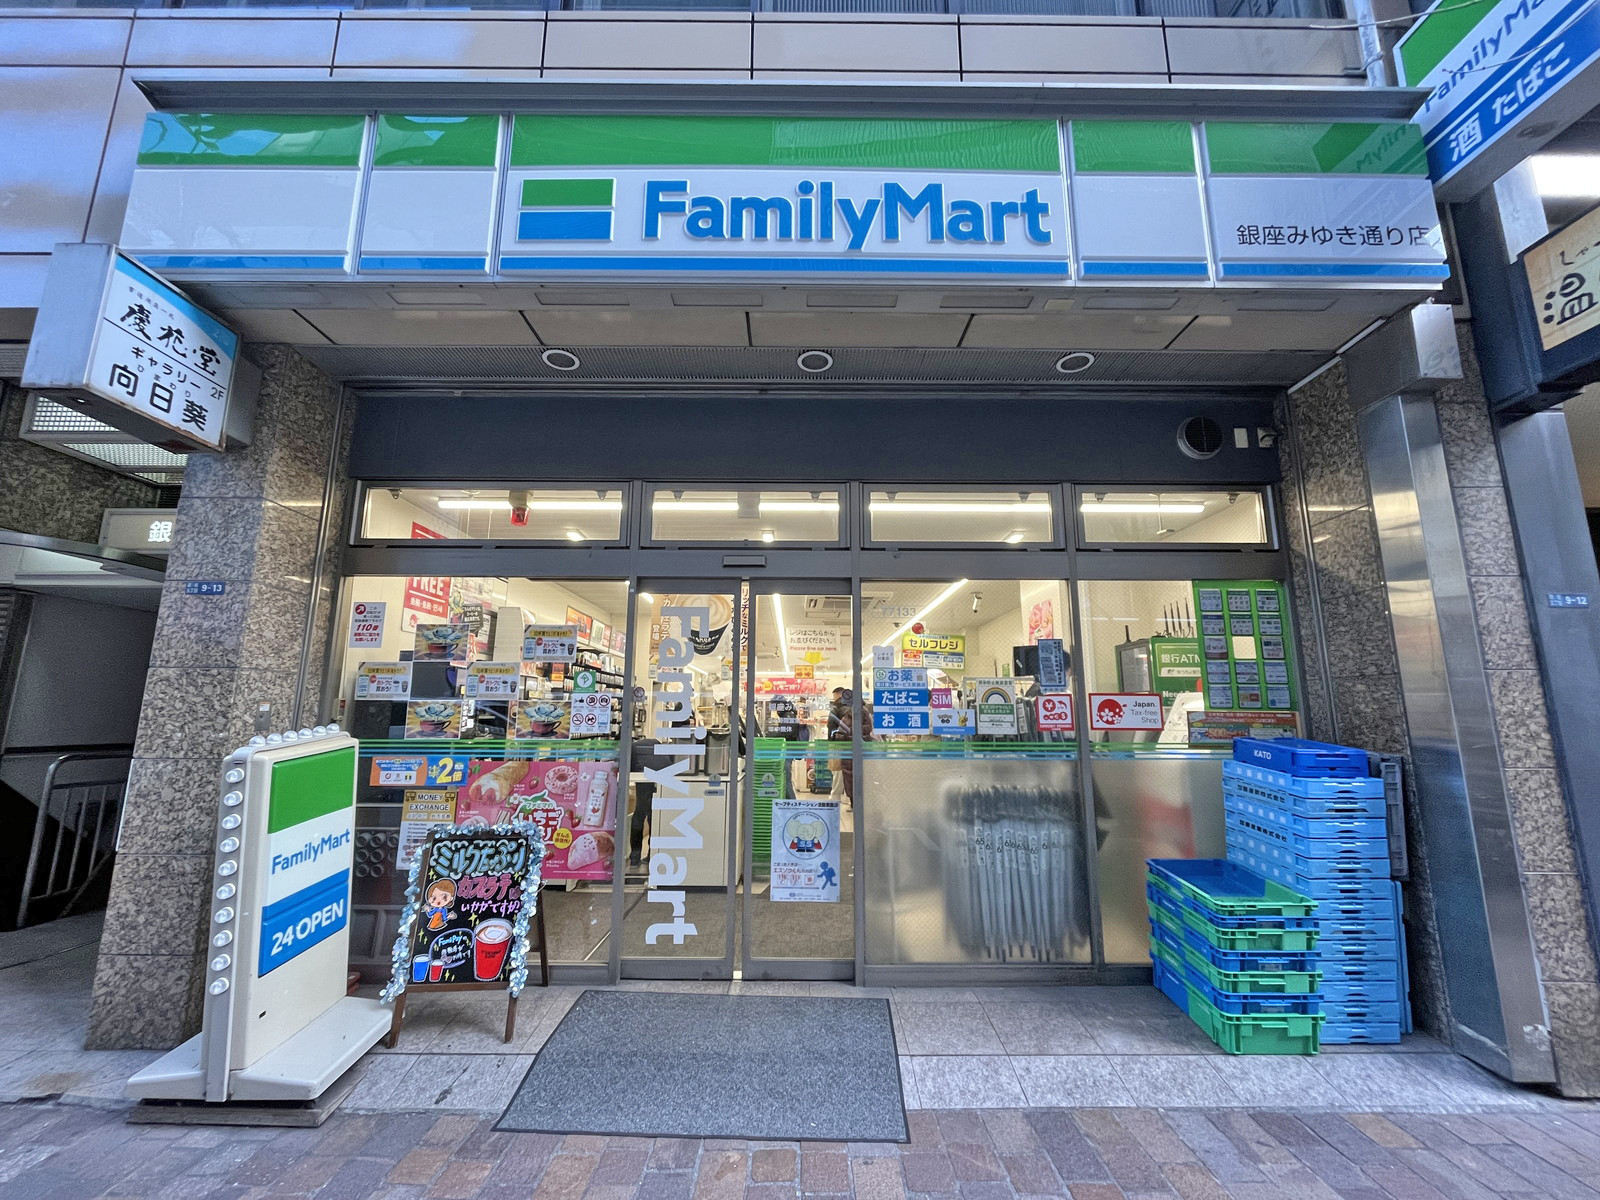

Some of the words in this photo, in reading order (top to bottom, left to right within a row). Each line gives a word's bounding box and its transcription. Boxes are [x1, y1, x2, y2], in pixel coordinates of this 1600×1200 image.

[1449, 112, 1482, 161] 酒
[1492, 42, 1570, 124] たばこ
[642, 178, 1053, 253] FamilyMart
[1236, 225, 1431, 247] 銀座みゆき通り店
[1560, 241, 1600, 266] しゃ
[131, 346, 202, 389] ギャラリー
[210, 387, 225, 401] 2F
[108, 363, 209, 432] 向日葵
[201, 584, 222, 592] 9-13
[1564, 596, 1588, 605] 9-12
[909, 638, 959, 650] セルフレジ
[888, 669, 913, 682] お薬
[881, 691, 920, 705] たばこ
[932, 694, 952, 705] SIM
[1141, 717, 1159, 725] Shop
[1253, 749, 1272, 760] KATO
[643, 606, 711, 945] FamilyMart
[518, 810, 562, 826] いちご
[271, 829, 351, 875] FamilyMart
[434, 843, 525, 876] ミルクたっぷり
[461, 900, 520, 917] いかがですか?
